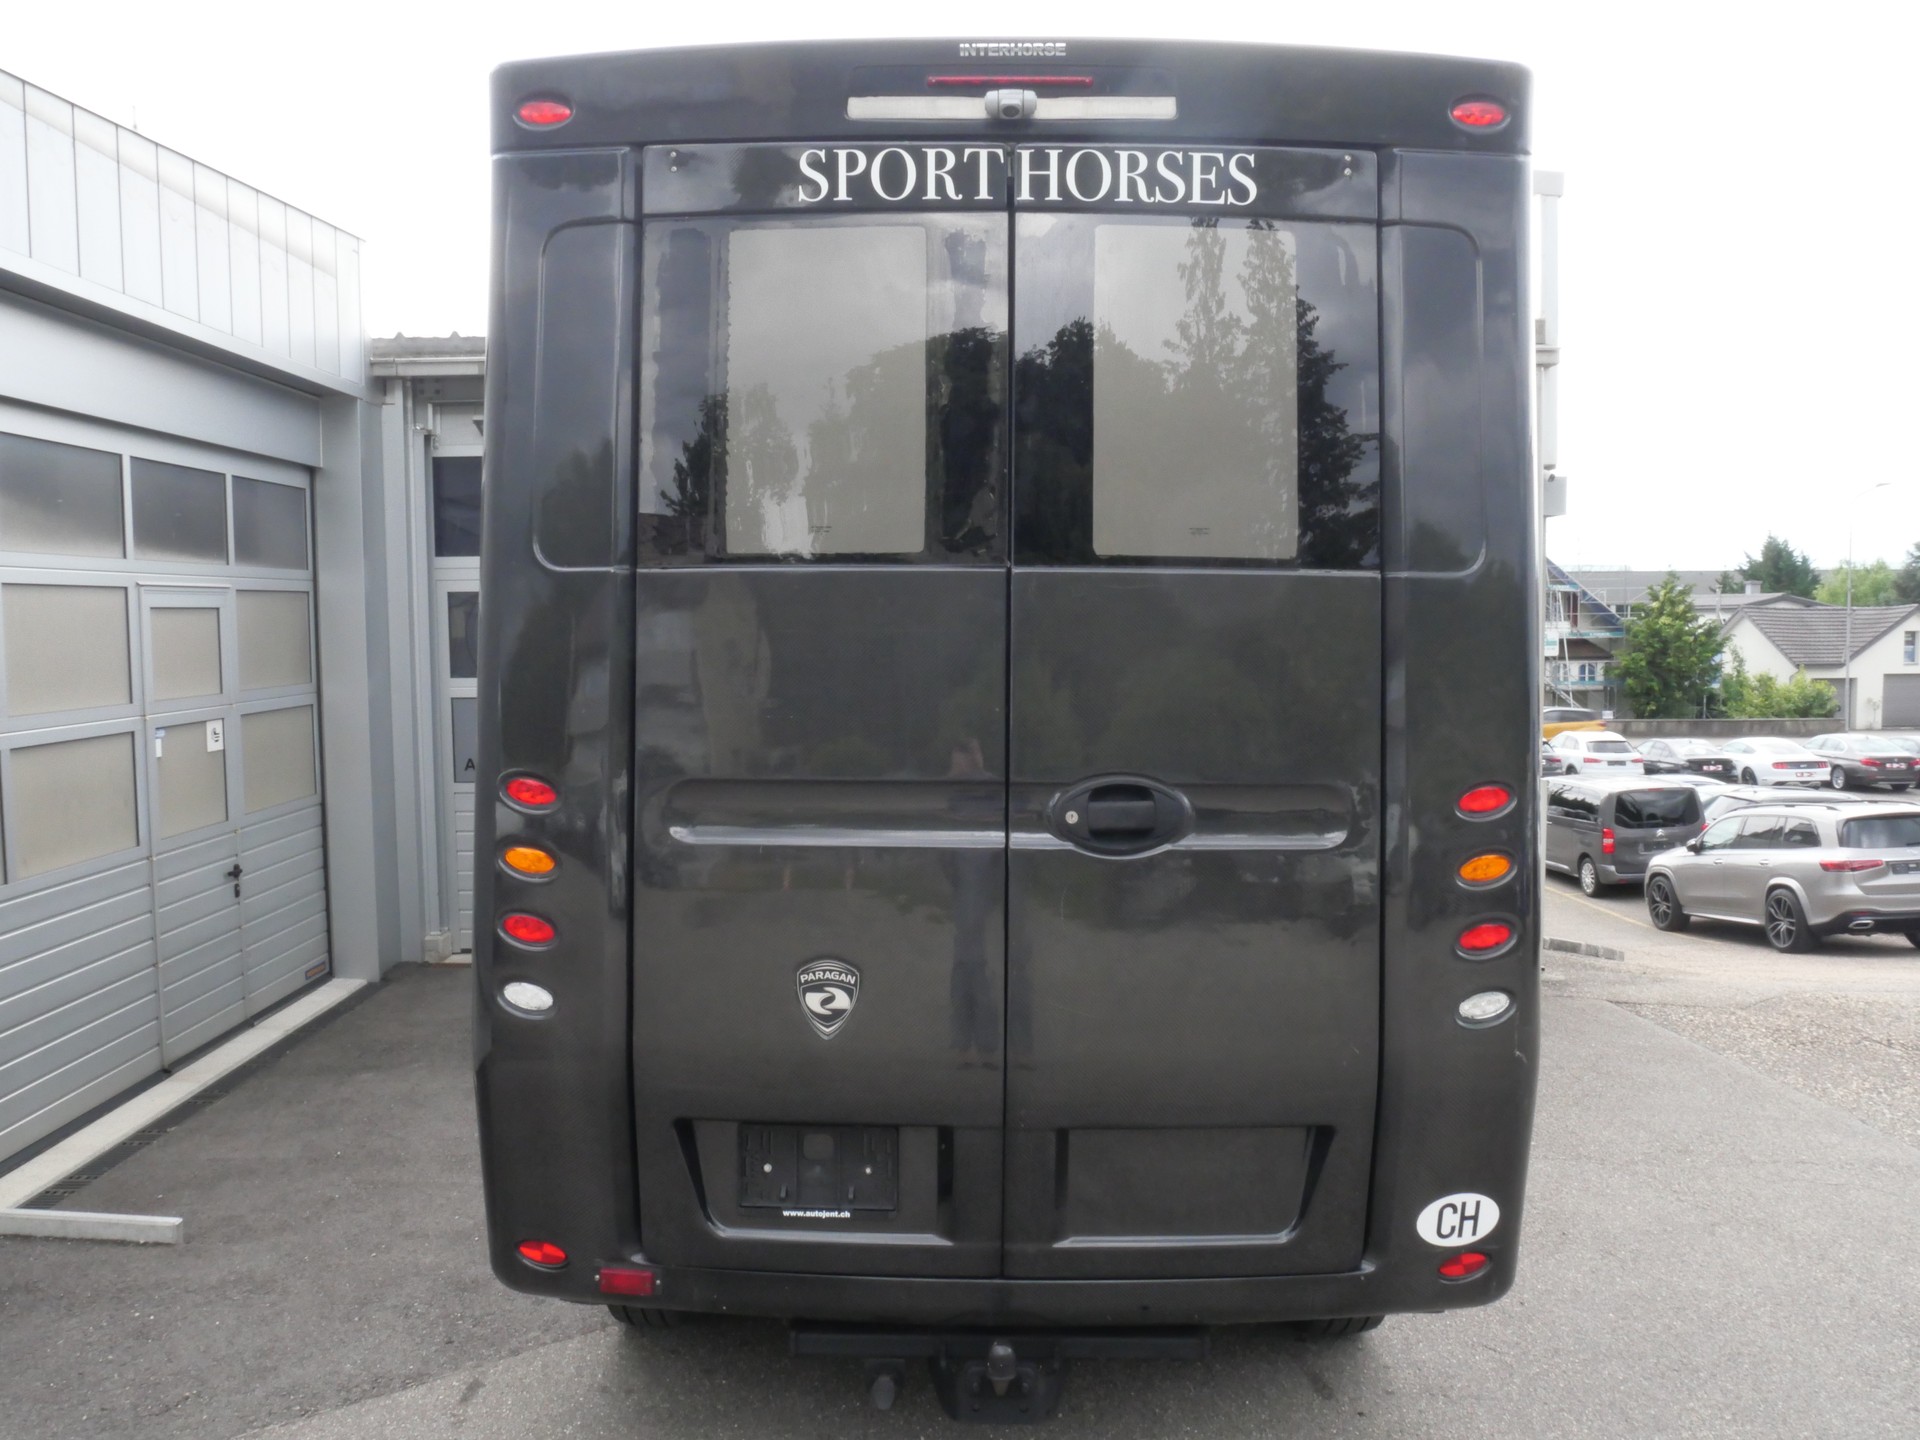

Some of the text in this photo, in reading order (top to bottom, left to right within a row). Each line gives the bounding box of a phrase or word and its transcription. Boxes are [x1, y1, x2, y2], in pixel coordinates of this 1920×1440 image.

[959, 42, 1067, 57] INTERHORSE
[798, 147, 1258, 205] SPORT HORSES
[800, 970, 856, 984] PARAGAN
[782, 1210, 851, 1219] www.autojent.ch
[1436, 1200, 1481, 1239] CH
